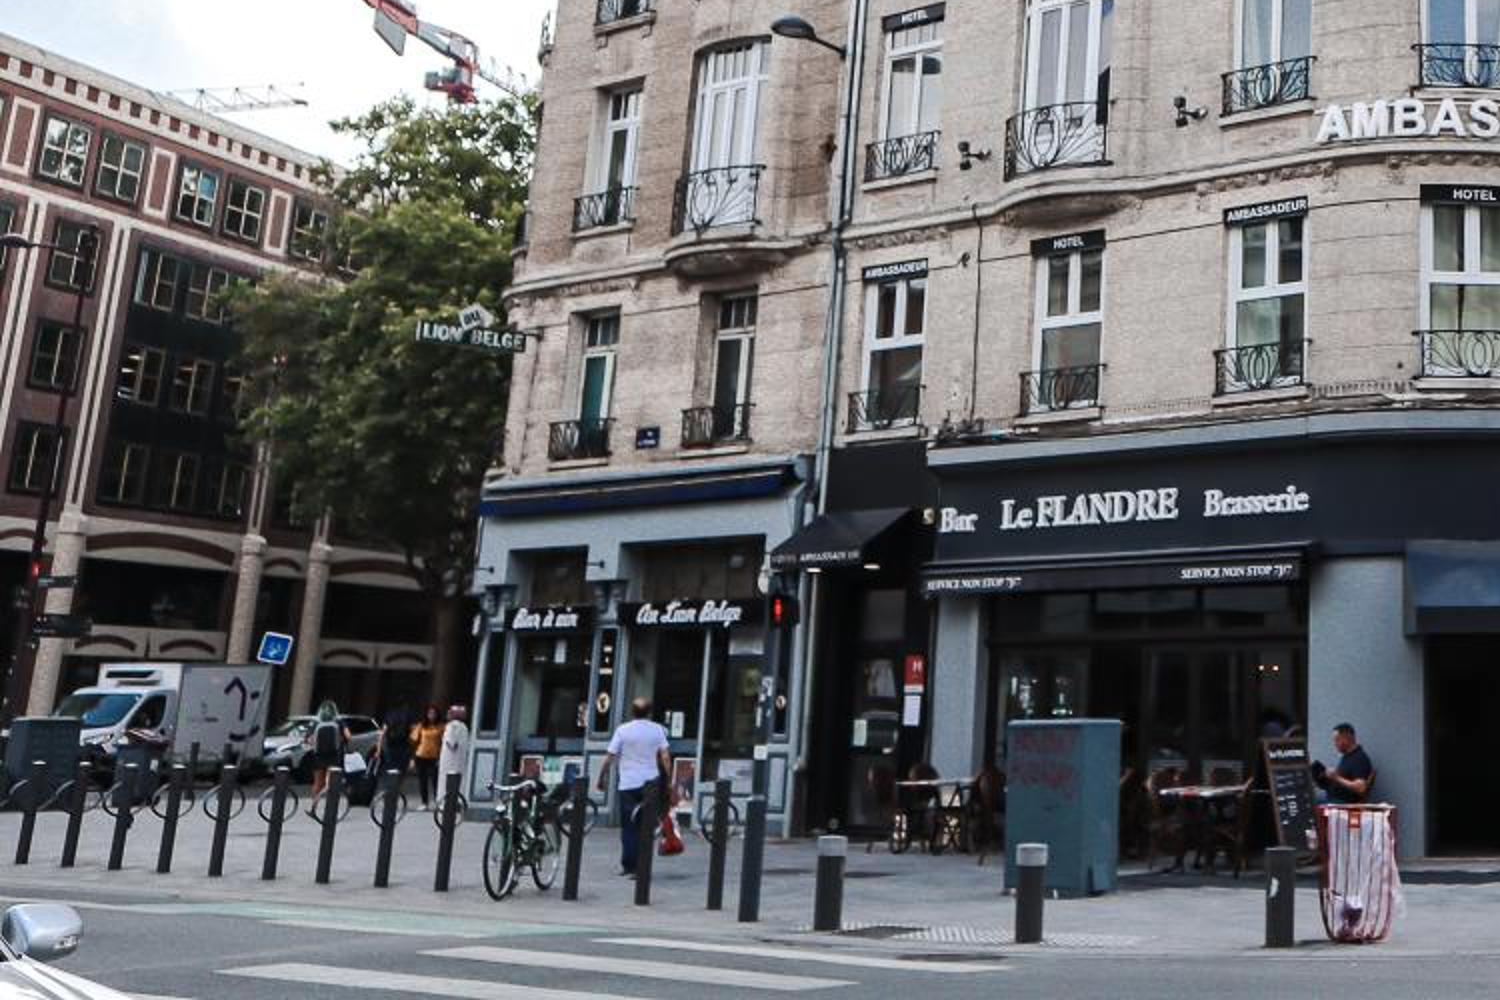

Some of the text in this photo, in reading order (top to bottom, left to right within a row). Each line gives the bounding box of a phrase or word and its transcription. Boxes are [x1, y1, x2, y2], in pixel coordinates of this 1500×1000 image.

[1453, 188, 1496, 201] HOTEL
[1227, 200, 1307, 221] AMBASSADEUR
[1053, 236, 1086, 249] HOTEL
[865, 258, 928, 277] AMBASSADEUR
[423, 322, 525, 350] LION BELGE
[940, 485, 1310, 533] Bar Le FLANDRE Brasserie
[1181, 568, 1219, 579] SERVICE
[1221, 566, 1245, 577] NON
[1246, 565, 1272, 577] STOP
